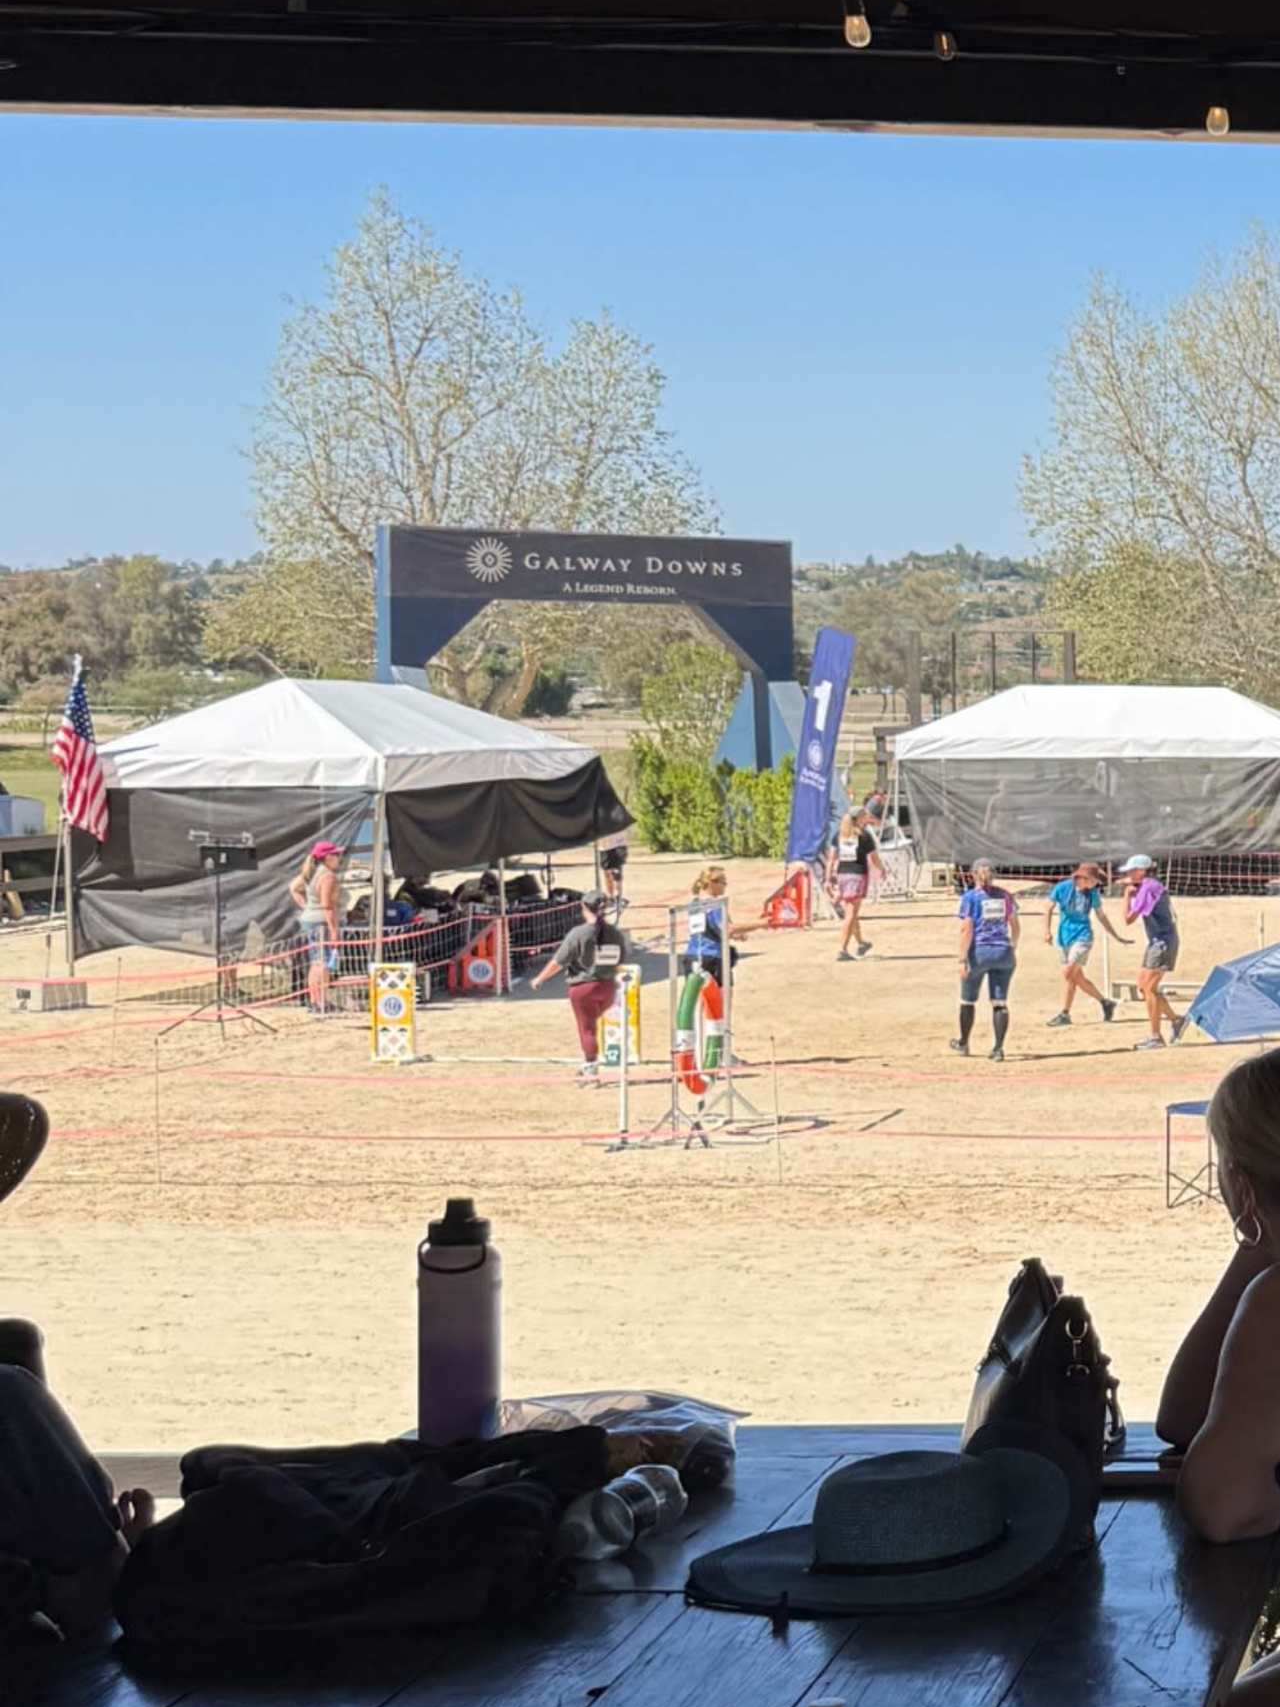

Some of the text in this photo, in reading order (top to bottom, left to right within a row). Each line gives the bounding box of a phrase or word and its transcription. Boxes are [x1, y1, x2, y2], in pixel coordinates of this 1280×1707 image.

[523, 553, 744, 577] GALWAY DOWNS
[562, 582, 573, 593] A
[813, 679, 833, 732] 1
